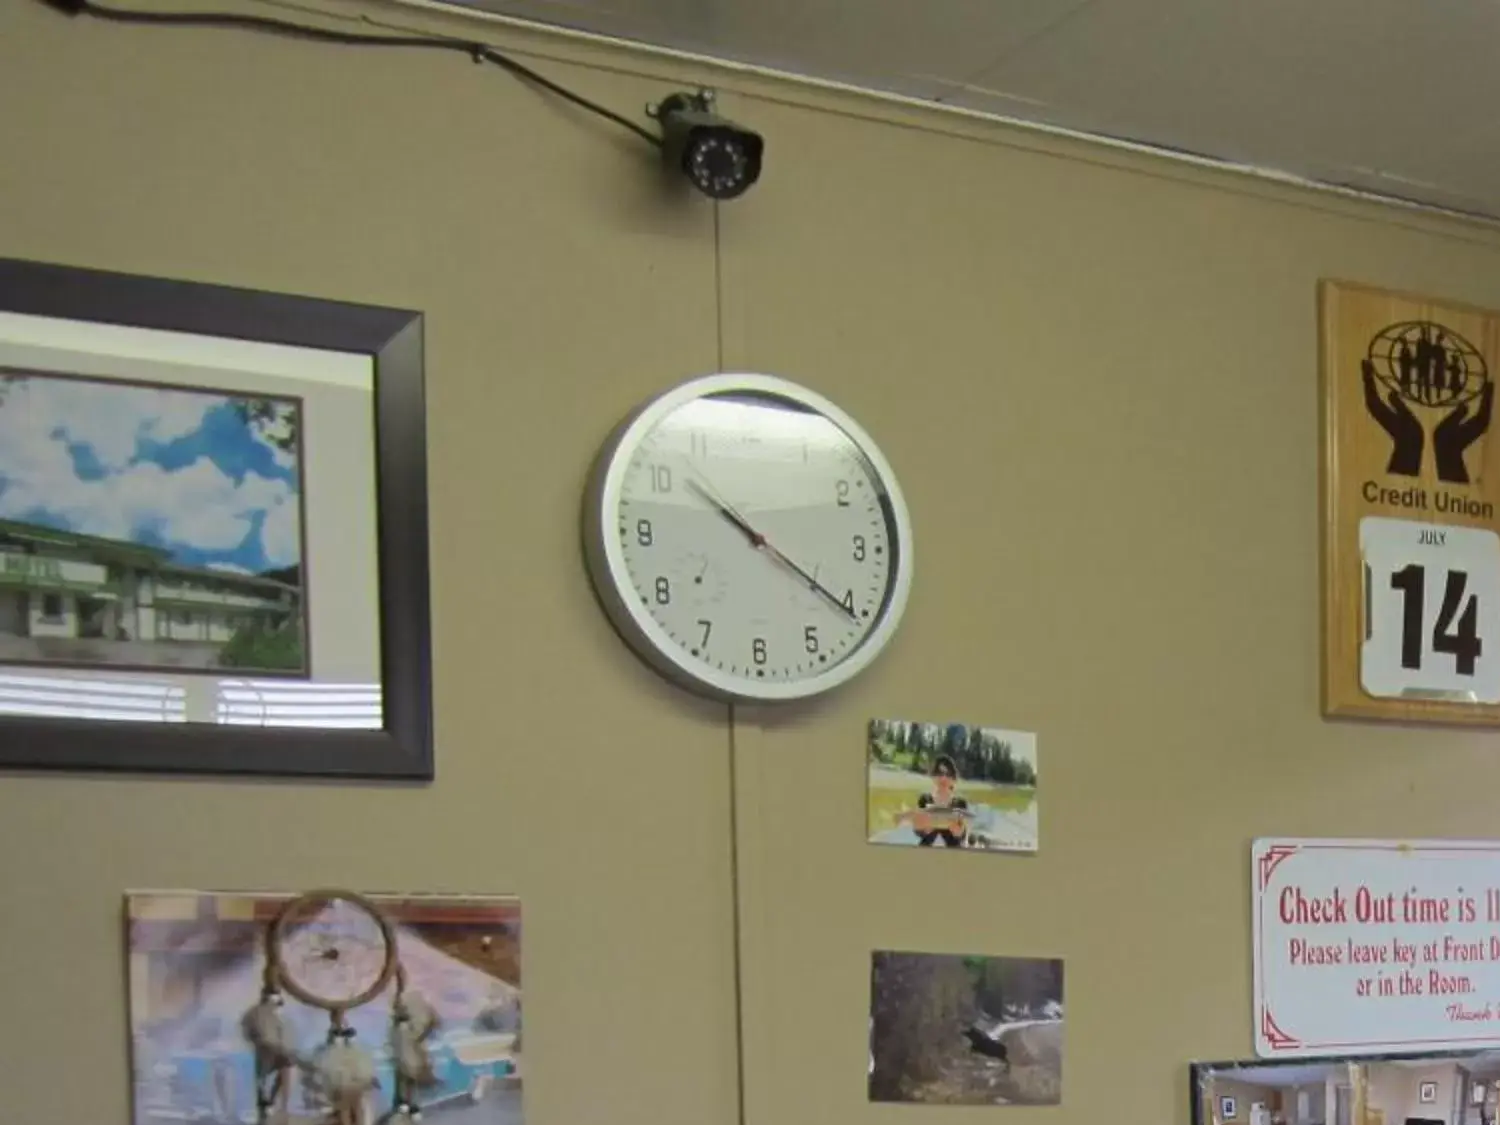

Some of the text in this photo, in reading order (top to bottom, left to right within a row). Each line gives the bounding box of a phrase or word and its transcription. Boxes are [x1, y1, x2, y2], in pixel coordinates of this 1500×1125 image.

[649, 464, 672, 493] 10
[1362, 480, 1494, 520] Credit Union
[853, 535, 865, 561] 3
[1418, 529, 1446, 546] JULY
[655, 576, 670, 604] 8
[697, 620, 712, 647] 7
[1390, 563, 1483, 676] 14
[752, 639, 767, 665] 6
[804, 626, 819, 654] 5
[1280, 885, 1347, 924] Check
[1355, 885, 1396, 924] Out
[1403, 887, 1449, 924] time
[1457, 887, 1475, 923] is
[1289, 938, 1342, 965] Please
[1348, 938, 1387, 963] leave
[1393, 938, 1417, 968] key
[1423, 940, 1437, 962] at
[1444, 936, 1485, 962] Front
[1356, 969, 1476, 997] or in the Room.
